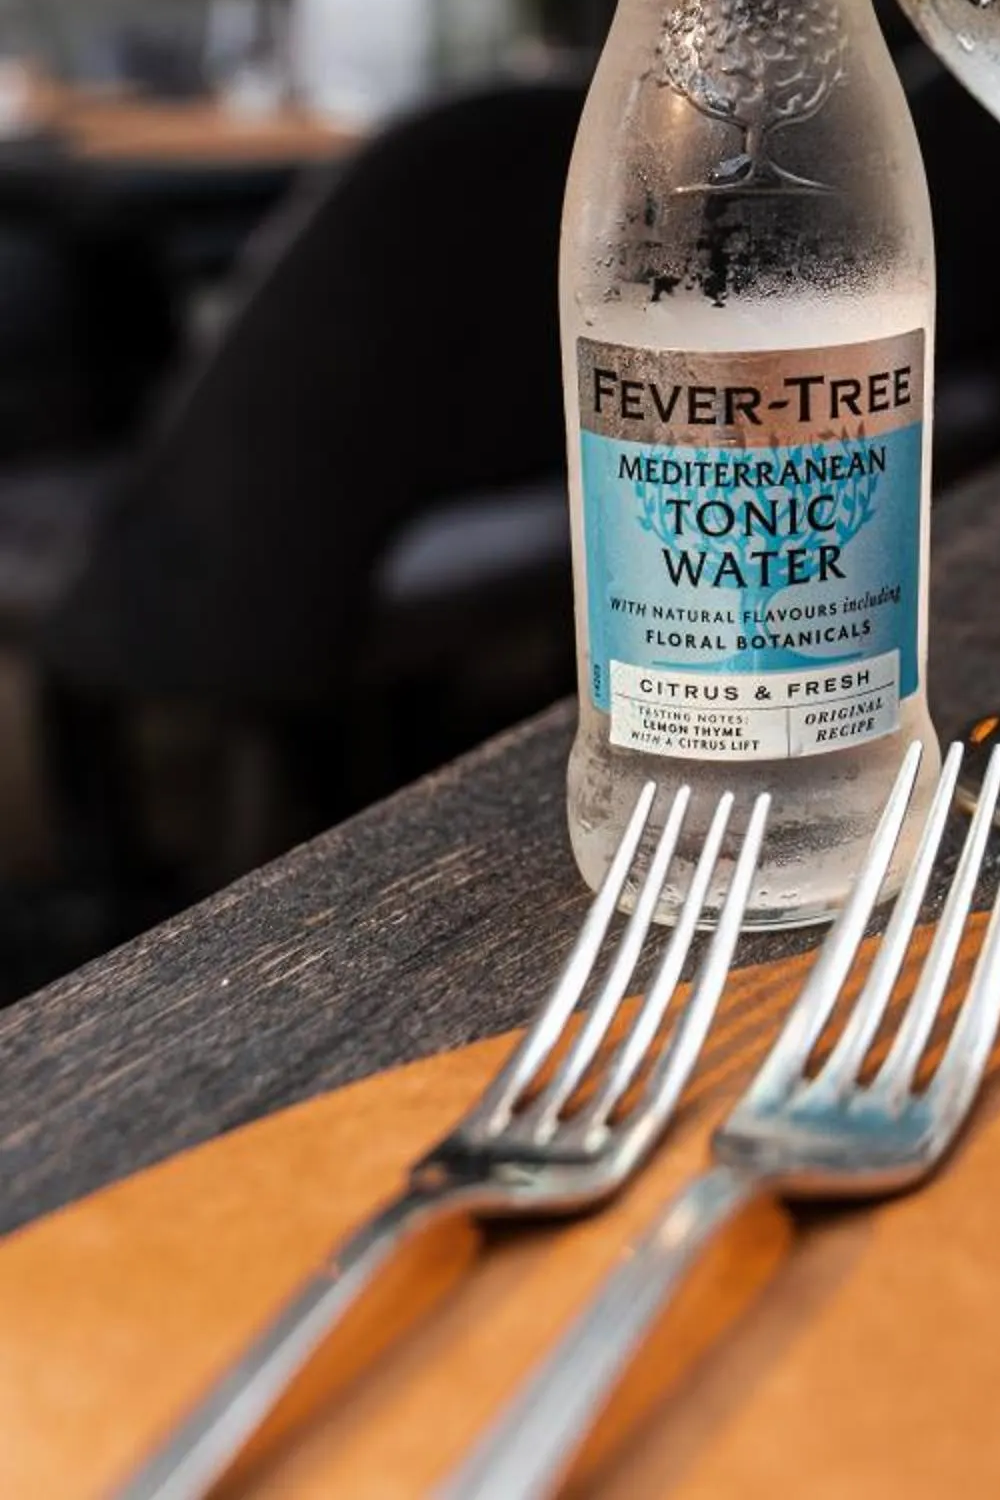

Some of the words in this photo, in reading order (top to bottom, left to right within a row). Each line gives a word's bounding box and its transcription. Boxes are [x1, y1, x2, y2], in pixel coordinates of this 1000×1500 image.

[592, 365, 912, 425] FEVER-TREE
[618, 446, 887, 488] MEDITERRANEAN
[665, 494, 837, 538] TONIC
[663, 543, 847, 589] WATER
[610, 596, 647, 617] WITH
[652, 605, 735, 624] NATURAL
[743, 602, 838, 624] FLAVOURS
[842, 584, 901, 614] including
[645, 629, 727, 649] FLORAL
[736, 619, 871, 650] BOTANICALS
[639, 678, 739, 701] CITRUS
[754, 686, 772, 701] &
[787, 670, 871, 698] FRESH
[804, 697, 884, 726] ORIGINAL
[631, 731, 661, 745] WITH
[678, 737, 727, 751] CITRUS
[731, 739, 760, 751] LIFT
[642, 719, 689, 735] LEMON
[693, 725, 743, 737] THYME
[815, 717, 875, 743] RECIPE
